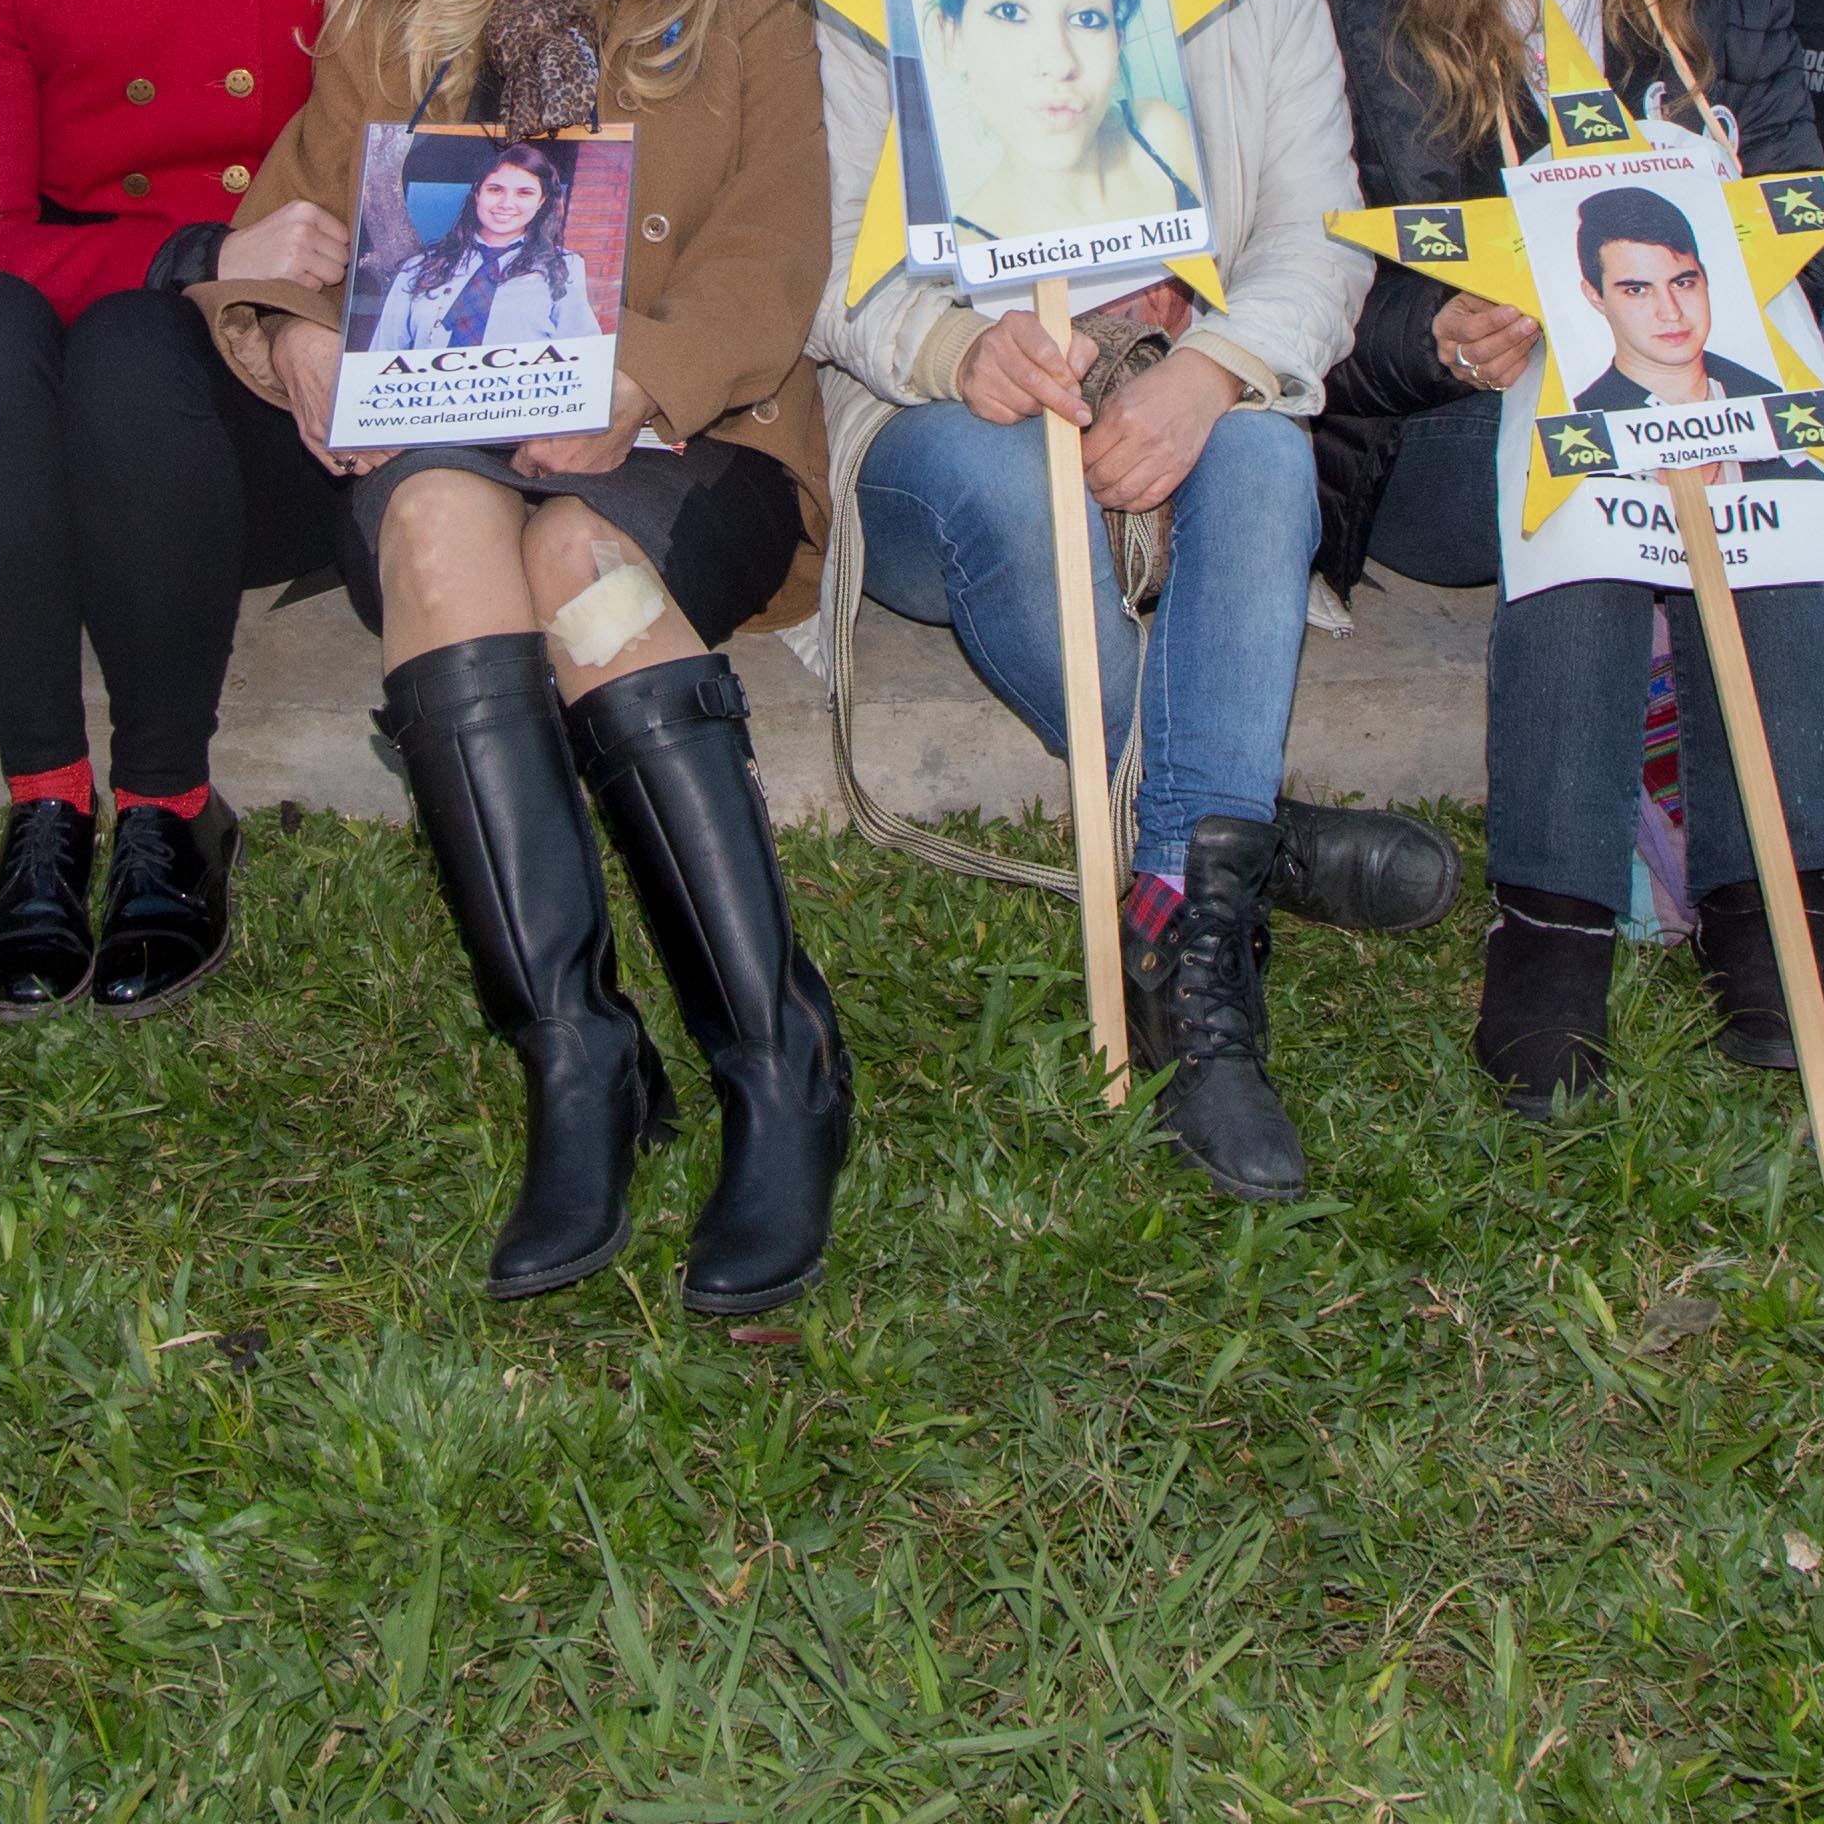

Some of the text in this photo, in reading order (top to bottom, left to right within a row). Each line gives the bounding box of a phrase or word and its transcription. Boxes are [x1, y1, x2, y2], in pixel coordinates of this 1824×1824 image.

[1530, 157, 1694, 184] VERDAD Y JUSTICIA
[987, 238, 1083, 279] Justicia
[1084, 234, 1132, 263] por
[1137, 217, 1192, 247] Mili
[378, 344, 580, 375] A.C.C.A.
[368, 370, 580, 395] ASOCIACION CIVIL
[358, 401, 587, 428] www.carlaarduini.org.ar
[1626, 407, 1755, 444] YOAQUÍN
[1659, 444, 1738, 464] 23/04/2015
[1595, 495, 1780, 535] YOAUÍN
